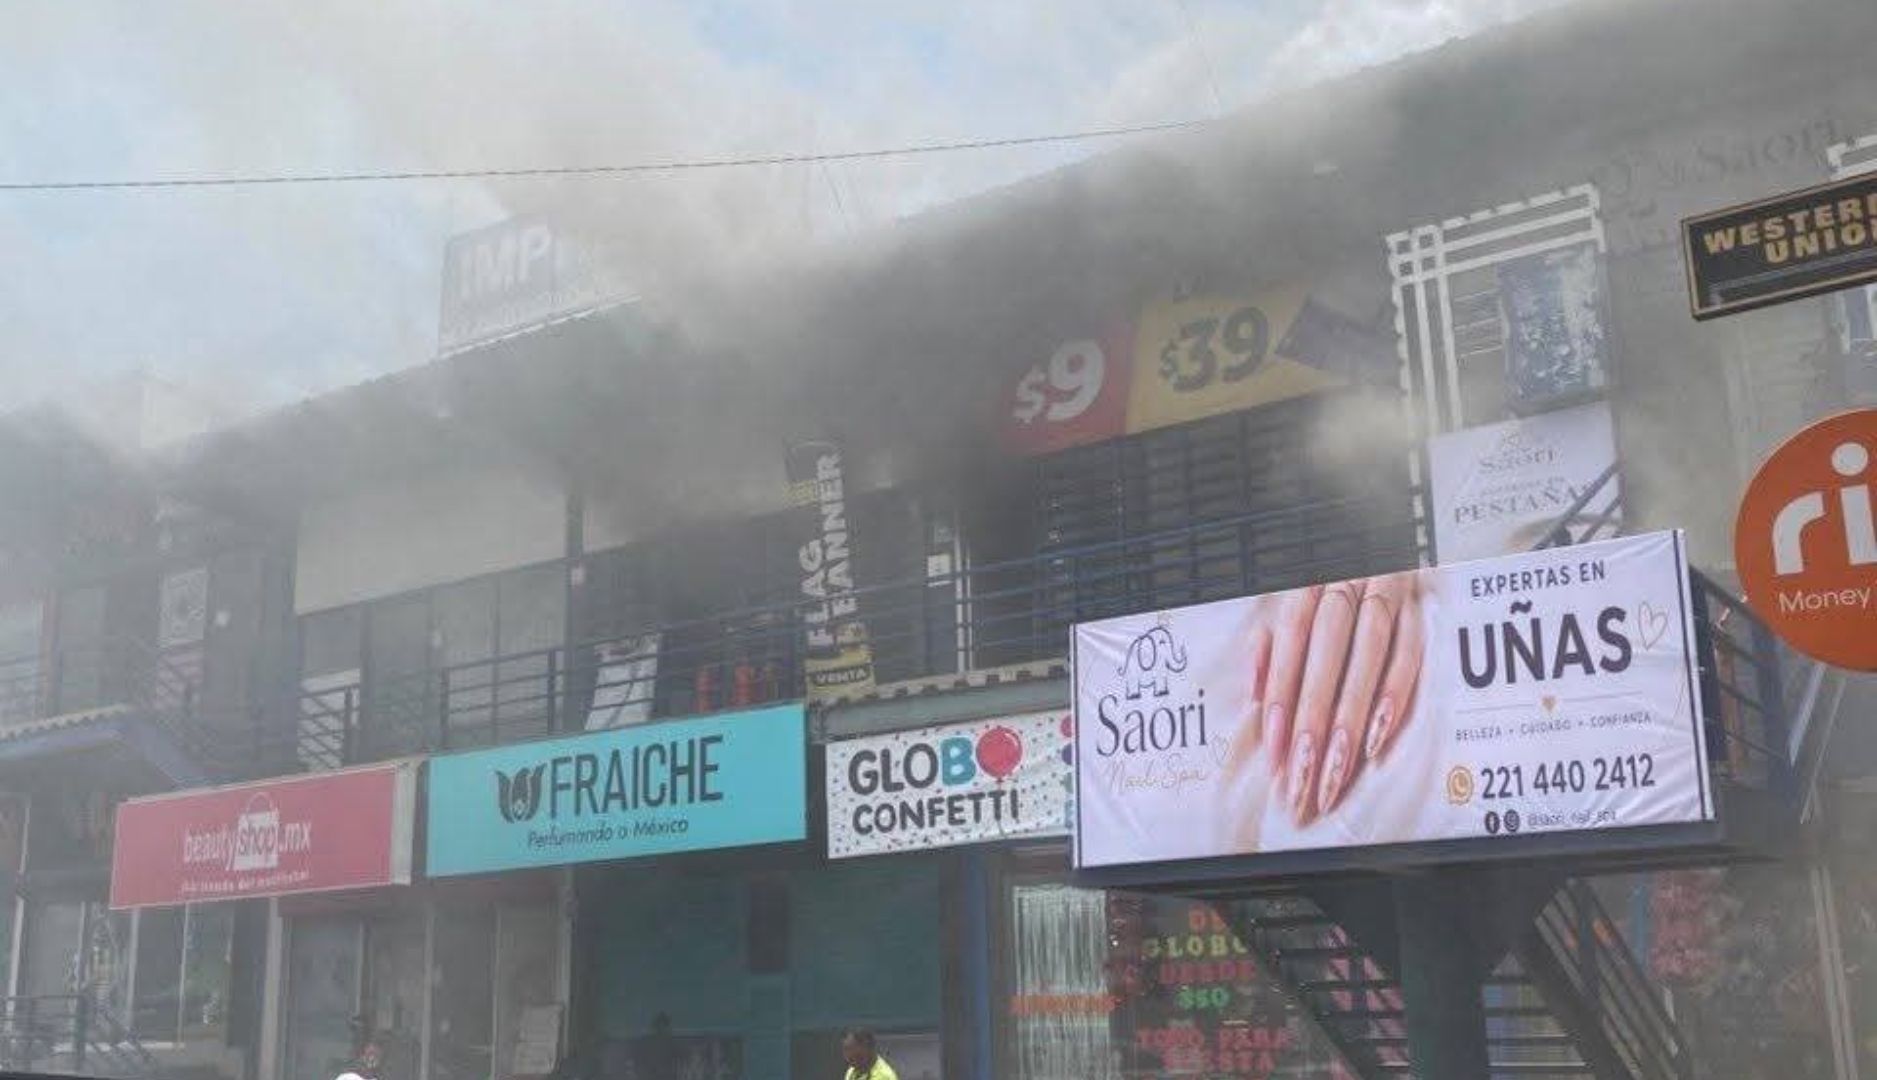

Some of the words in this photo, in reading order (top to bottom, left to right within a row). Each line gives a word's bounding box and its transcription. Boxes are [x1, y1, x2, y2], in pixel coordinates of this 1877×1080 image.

[1159, 306, 1270, 393] $39
[1012, 339, 1106, 424] $9
[1471, 565, 1571, 598] EXPERTAS
[1579, 560, 1605, 582] EN
[1779, 586, 1872, 614] Money
[1458, 600, 1632, 689] UÑAS
[1097, 688, 1208, 757] Saori
[1456, 726, 1502, 742] BELLEZA
[1520, 719, 1571, 736] CUIDADO
[1590, 711, 1653, 729] CONFIANZA
[551, 734, 724, 819] FRAICHE
[1481, 765, 1524, 799] 221
[1533, 760, 1585, 795] 440
[1593, 753, 1655, 791] 2412
[528, 822, 614, 848] Perfumando
[618, 828, 630, 840] a
[633, 817, 689, 839] México
[853, 789, 1019, 835] CONFETTI
